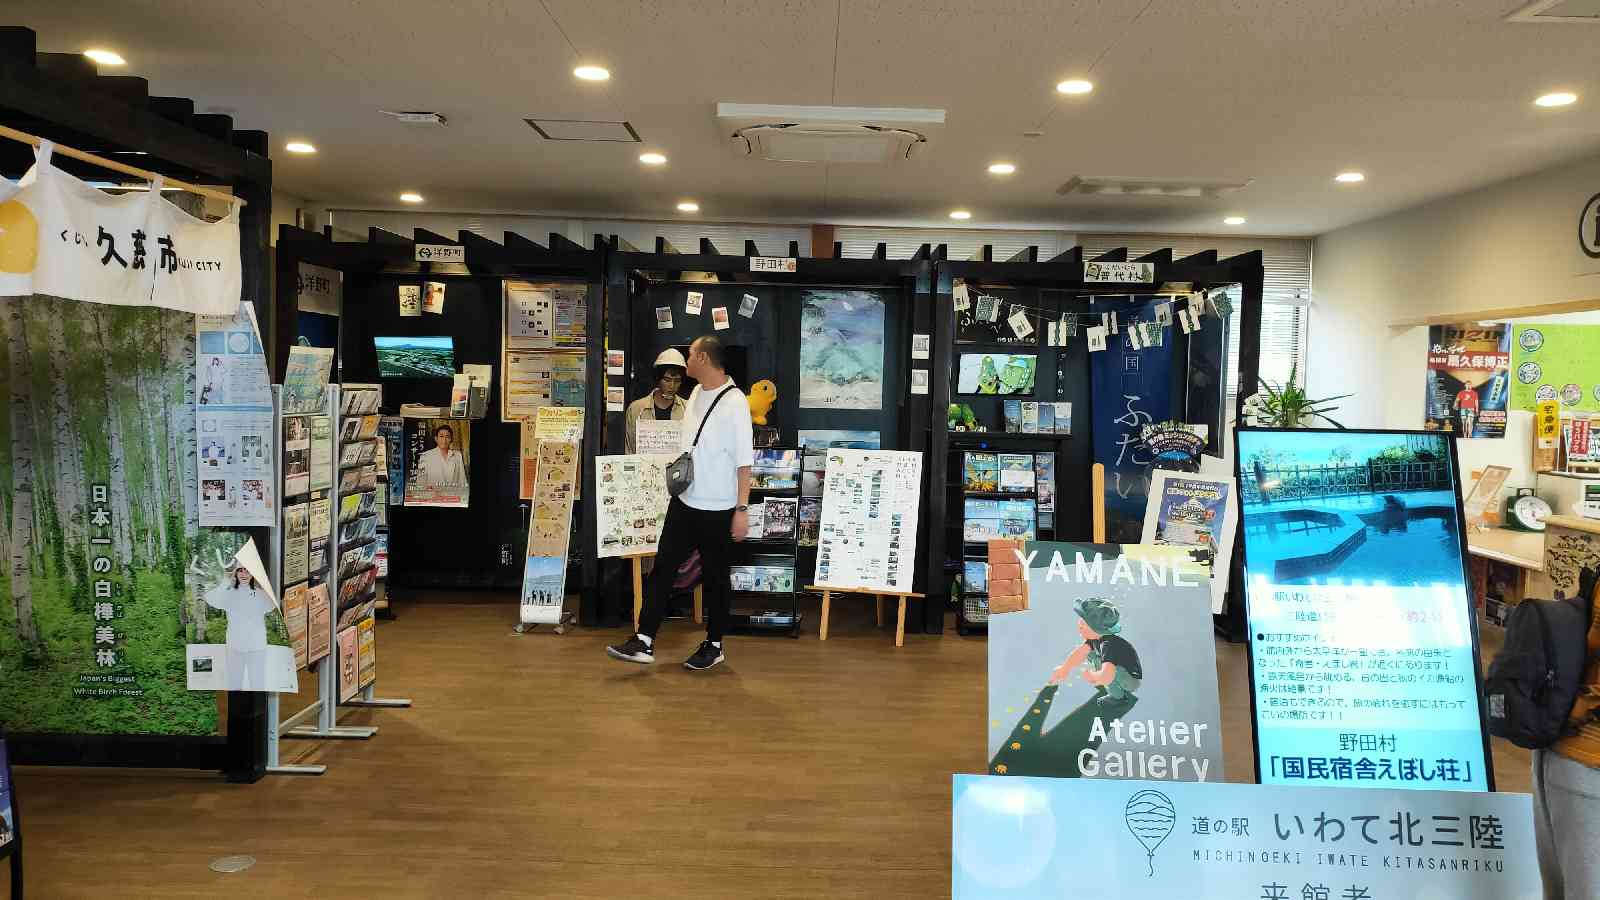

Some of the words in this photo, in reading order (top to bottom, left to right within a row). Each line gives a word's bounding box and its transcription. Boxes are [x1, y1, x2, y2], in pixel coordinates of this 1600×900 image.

[97, 226, 178, 274] 久慈市
[196, 261, 221, 271] CITY
[433, 247, 461, 257] 洋野町
[755, 258, 784, 270] 野田村
[1101, 271, 1143, 281] 普代村
[91, 484, 115, 667] 日本一の白樺美林
[1015, 549, 1199, 587] YAMANE
[74, 688, 97, 696] White
[98, 688, 117, 696] Birch
[118, 688, 144, 697] Forest
[1088, 717, 1209, 748] Atelier
[1339, 733, 1397, 753] 野田村
[1077, 748, 1209, 783] Gallery
[1270, 755, 1473, 783] 「国民宿舎えぼし荘」
[1191, 815, 1250, 838] 道の駅
[1273, 811, 1506, 850] いわて北三陸
[1192, 849, 1303, 866] MICHINOEKI
[1317, 853, 1370, 868] IWATE
[1383, 856, 1505, 874] KITASANRIKU
[1260, 881, 1372, 900] 来館者
